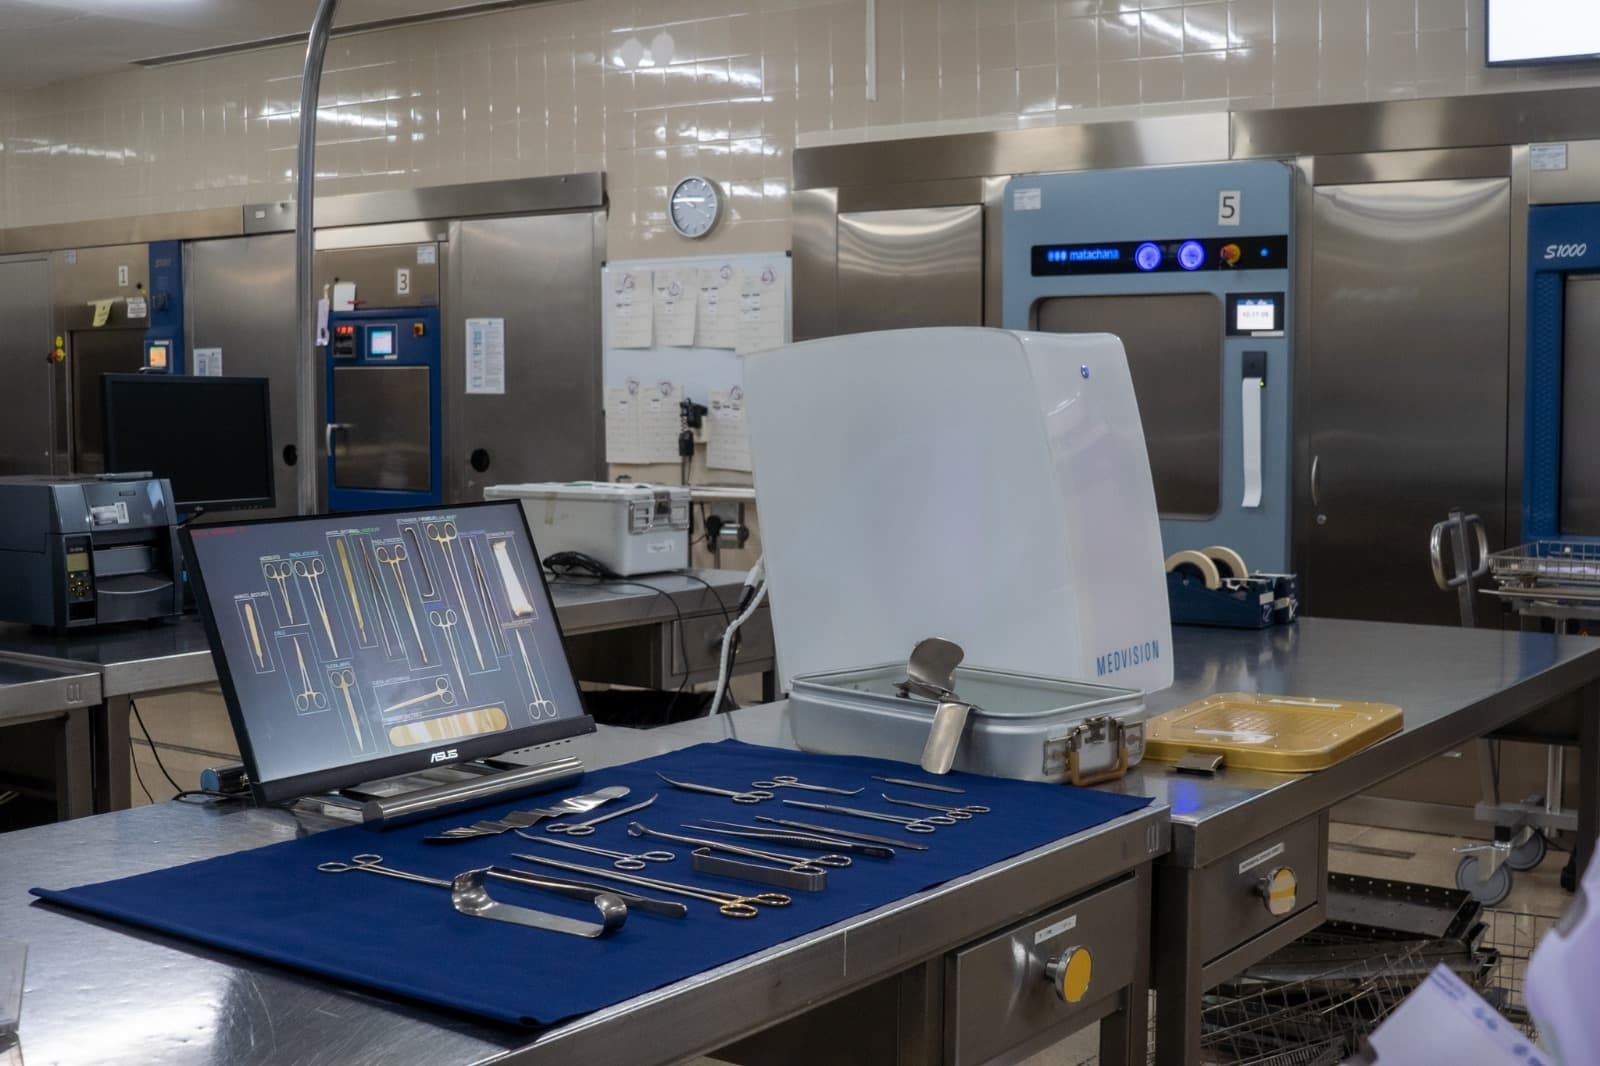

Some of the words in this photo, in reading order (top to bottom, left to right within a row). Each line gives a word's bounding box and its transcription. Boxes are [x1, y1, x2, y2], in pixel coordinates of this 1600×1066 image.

[1221, 195, 1235, 219] 5
[1069, 248, 1120, 262] matachana
[1544, 242, 1587, 259] S1000
[120, 268, 127, 283] 1
[399, 273, 407, 290] 3
[1096, 640, 1160, 677] MEDVISION
[430, 749, 458, 763] ASUS
